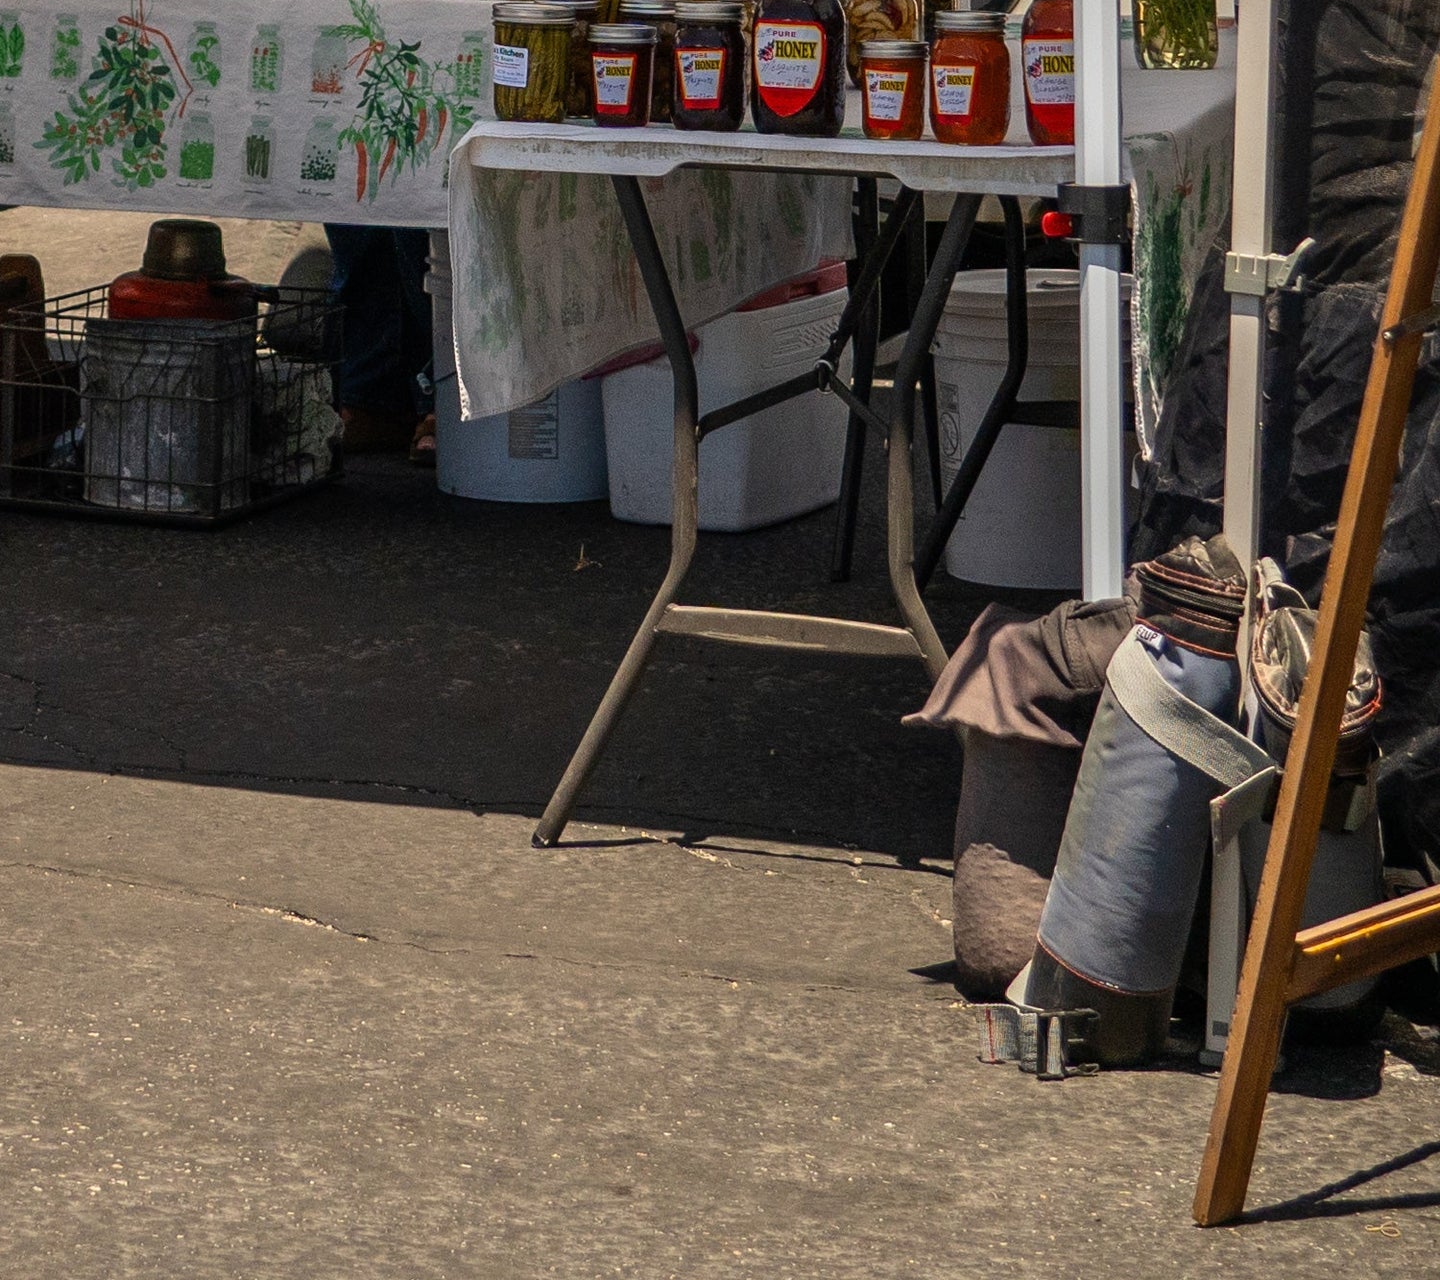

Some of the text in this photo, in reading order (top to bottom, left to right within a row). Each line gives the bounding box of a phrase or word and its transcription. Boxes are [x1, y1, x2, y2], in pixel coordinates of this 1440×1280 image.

[772, 30, 797, 38] PURE
[775, 40, 819, 60] HONEY
[694, 60, 721, 70] HONEY
[606, 66, 631, 77] HONEY
[946, 75, 973, 85] HONEY
[879, 80, 905, 91] HONEY
